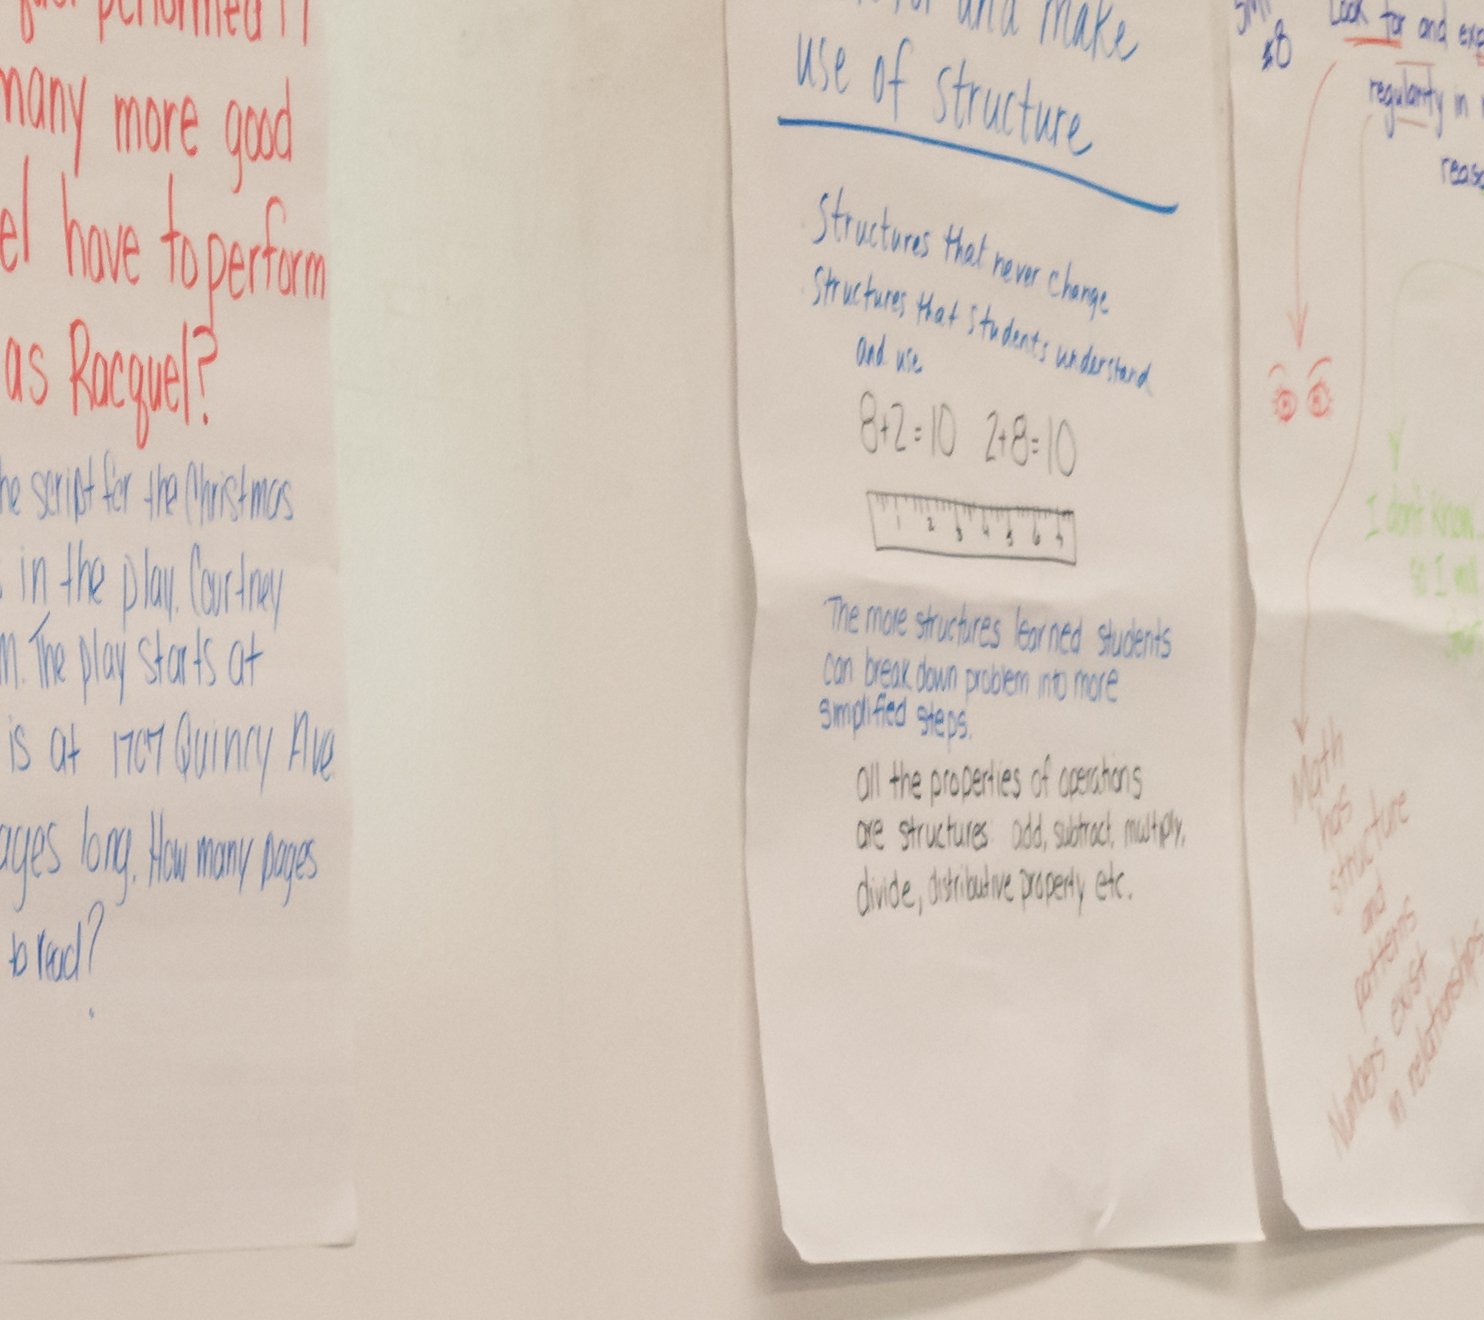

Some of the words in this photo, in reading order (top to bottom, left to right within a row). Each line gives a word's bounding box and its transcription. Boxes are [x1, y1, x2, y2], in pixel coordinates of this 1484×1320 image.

[797, 31, 850, 96] use
[872, 36, 914, 123] of
[115, 94, 199, 157] more
[225, 76, 293, 194] good
[160, 173, 198, 289] to
[206, 195, 327, 332] perform
[4, 336, 48, 405] as
[824, 594, 860, 636] The
[866, 603, 907, 639] more
[915, 603, 1001, 650] structures
[1014, 606, 1081, 656] learned
[1097, 616, 1172, 661] students
[50, 722, 80, 777] at
